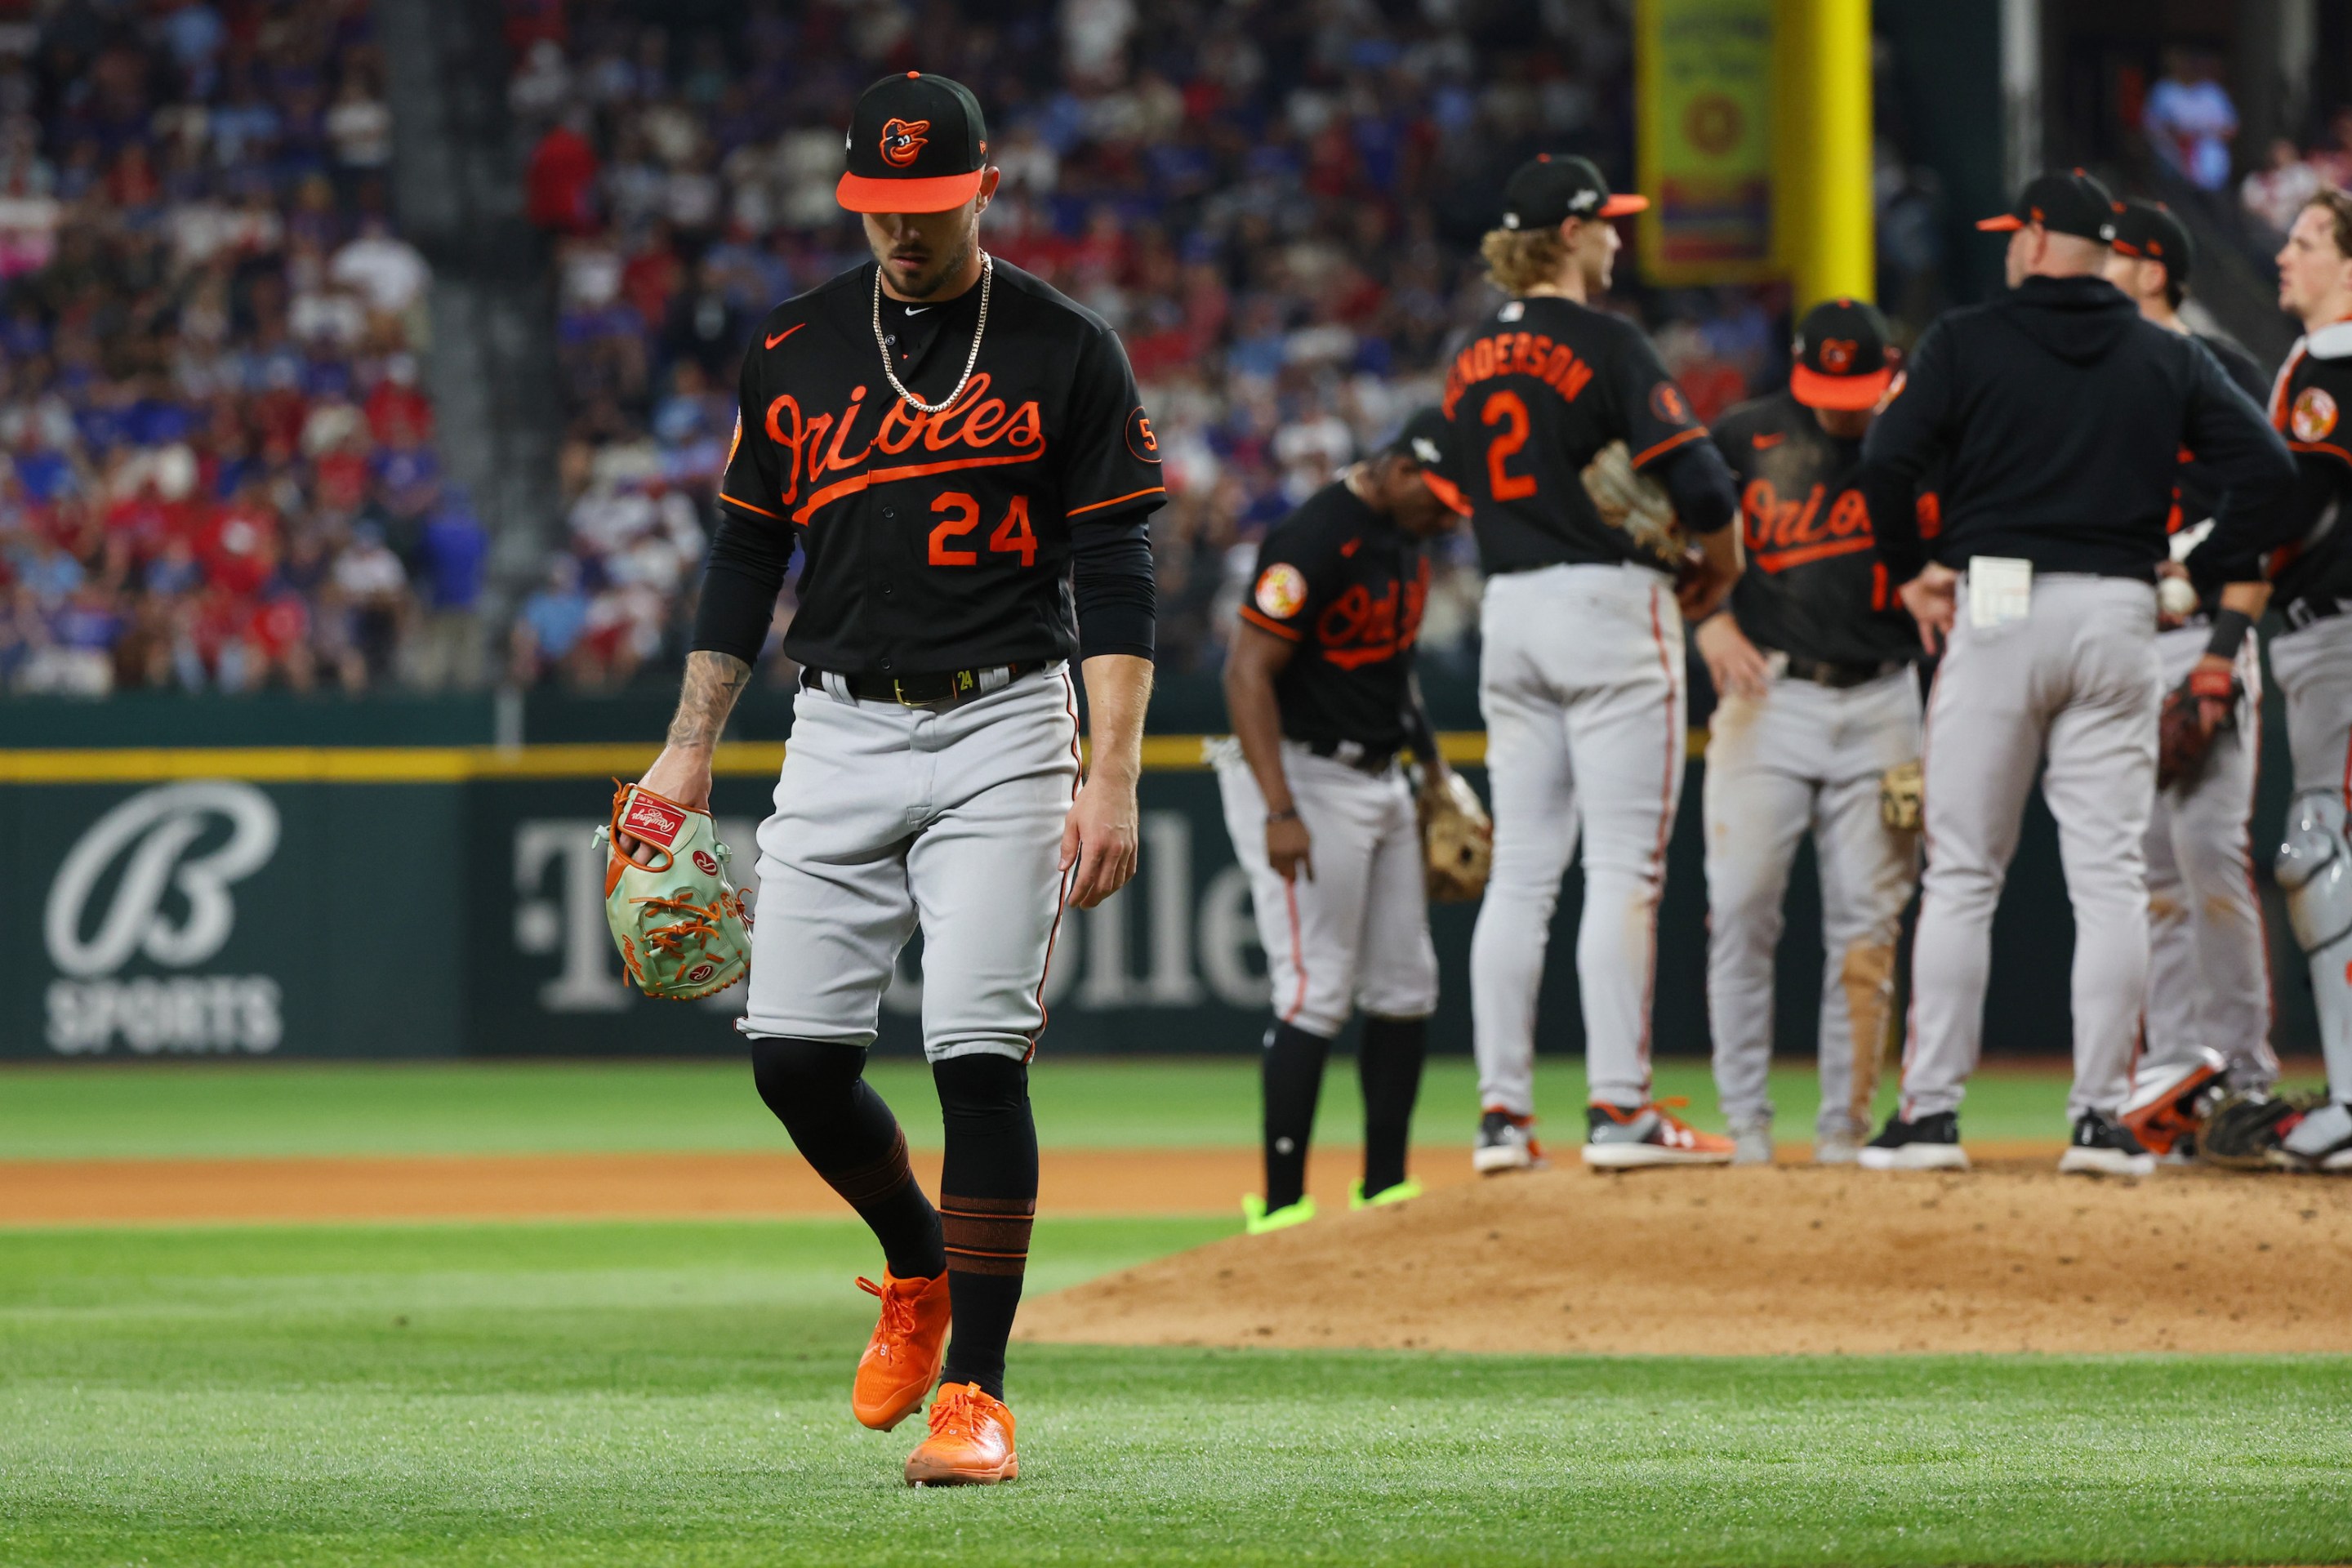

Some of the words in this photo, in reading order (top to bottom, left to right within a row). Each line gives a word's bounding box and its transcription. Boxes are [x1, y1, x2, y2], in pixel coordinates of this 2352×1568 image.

[764, 372, 1047, 510] Orioles
[1138, 417, 1159, 451] 5
[1481, 390, 1538, 501] 2
[929, 491, 1038, 567] 24
[957, 670, 973, 691] 24
[631, 808, 675, 832] Rawlings
[47, 975, 283, 1054] SPORTS
